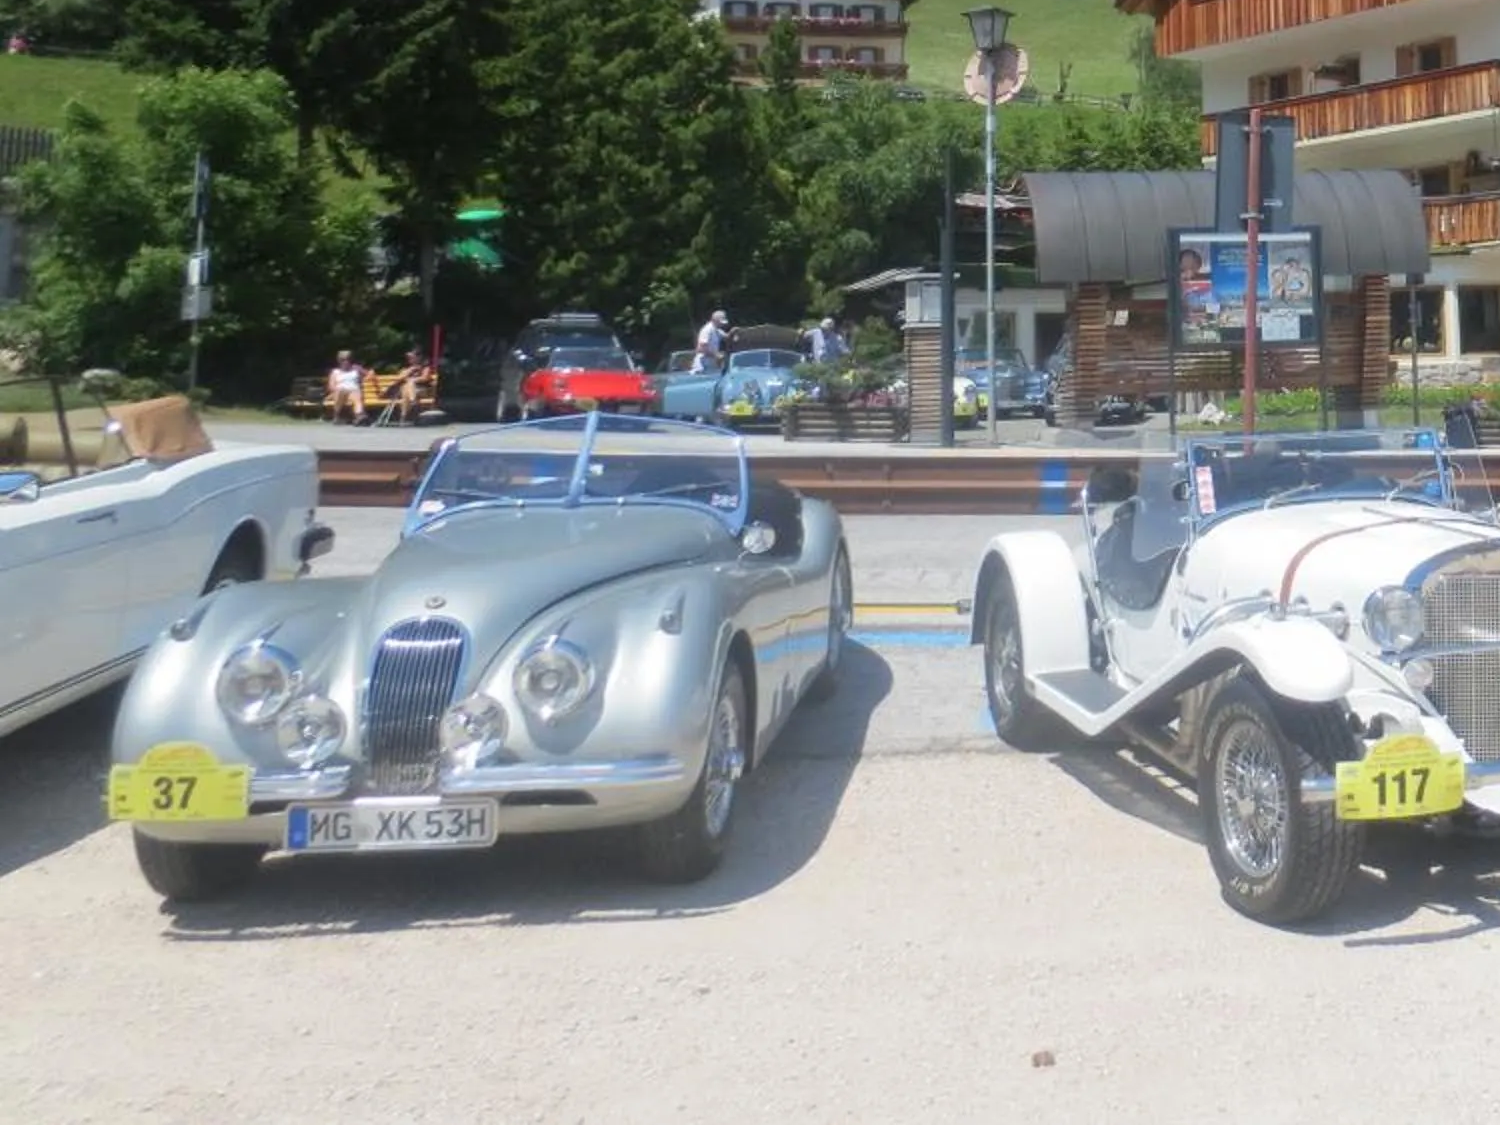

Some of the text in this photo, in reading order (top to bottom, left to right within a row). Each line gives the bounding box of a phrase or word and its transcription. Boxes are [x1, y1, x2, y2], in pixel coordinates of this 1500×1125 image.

[152, 776, 198, 810] 37
[1371, 767, 1430, 806] 117
[310, 807, 486, 841] MG XK 53H
